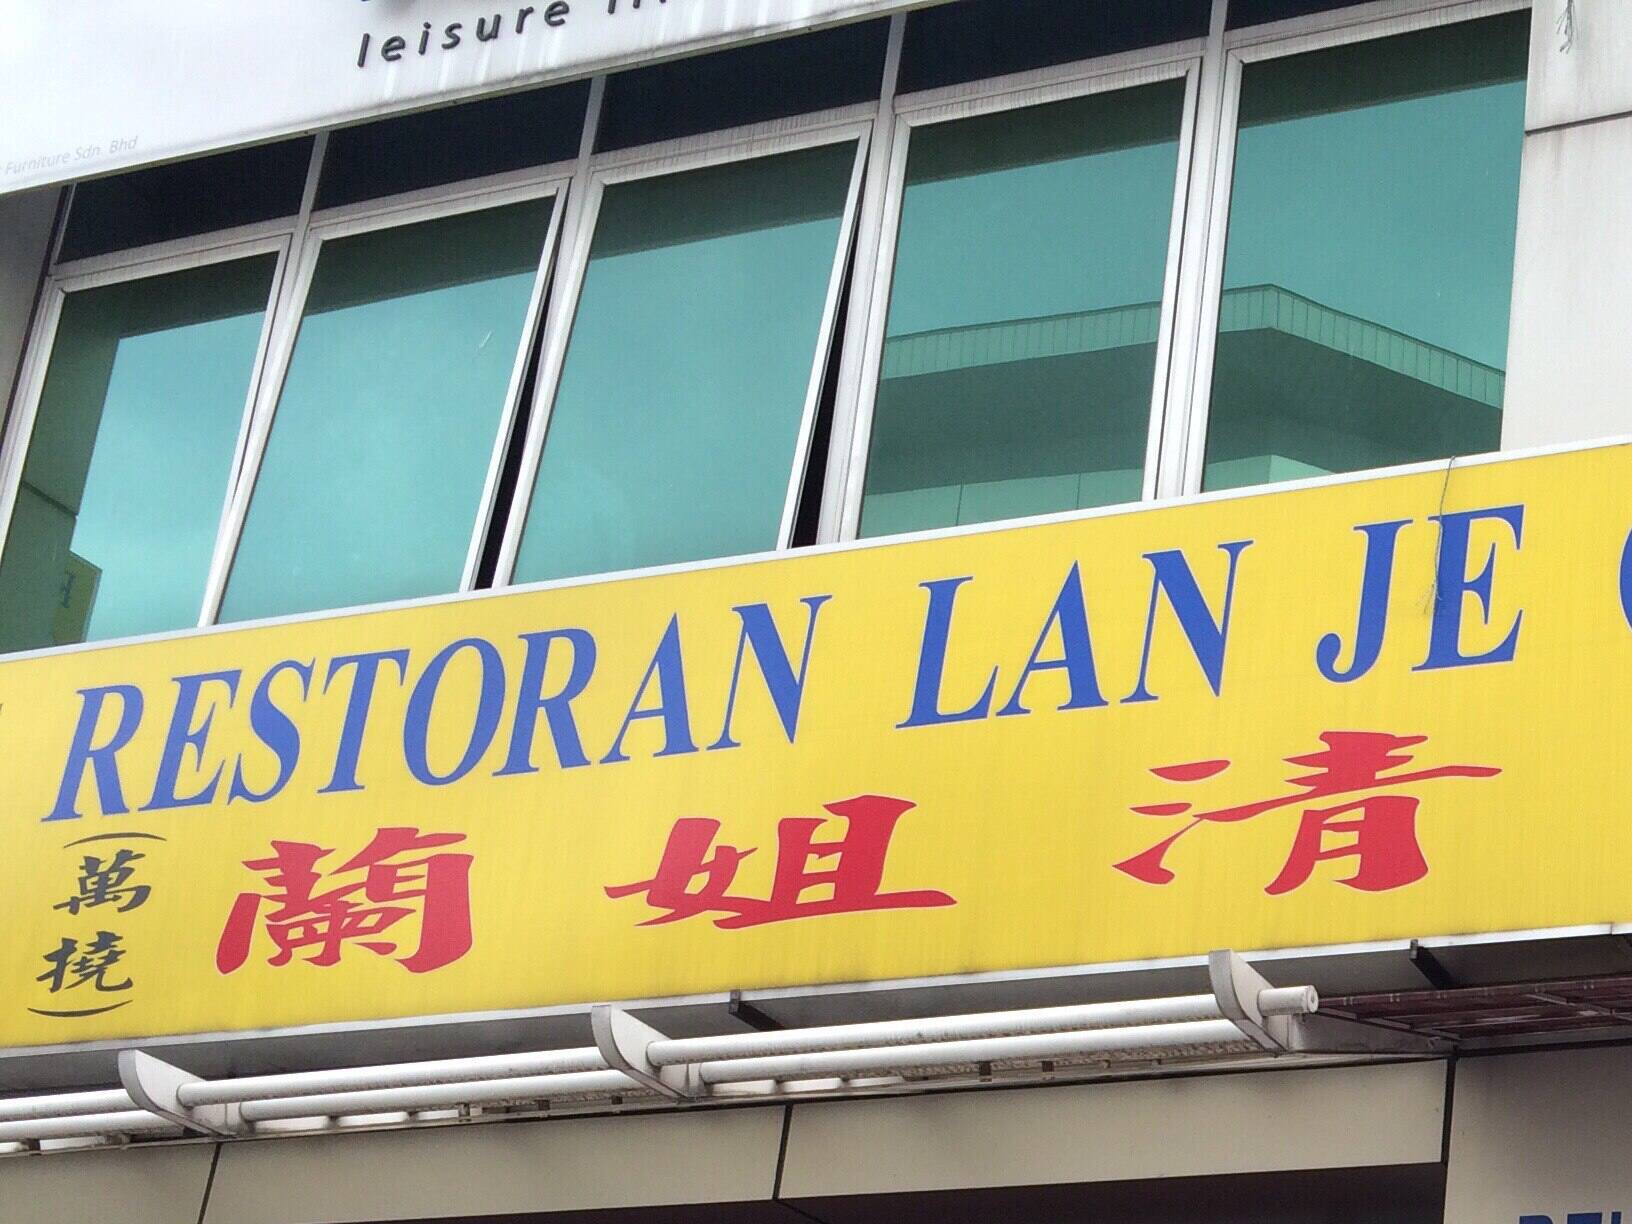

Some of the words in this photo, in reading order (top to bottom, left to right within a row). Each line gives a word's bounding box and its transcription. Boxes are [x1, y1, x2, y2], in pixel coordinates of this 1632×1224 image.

[358, 0, 569, 67] leisure
[5, 152, 71, 174] Furniture
[41, 594, 832, 823] RESTORAN
[897, 540, 1253, 730] LAN
[1316, 504, 1523, 683] JE
